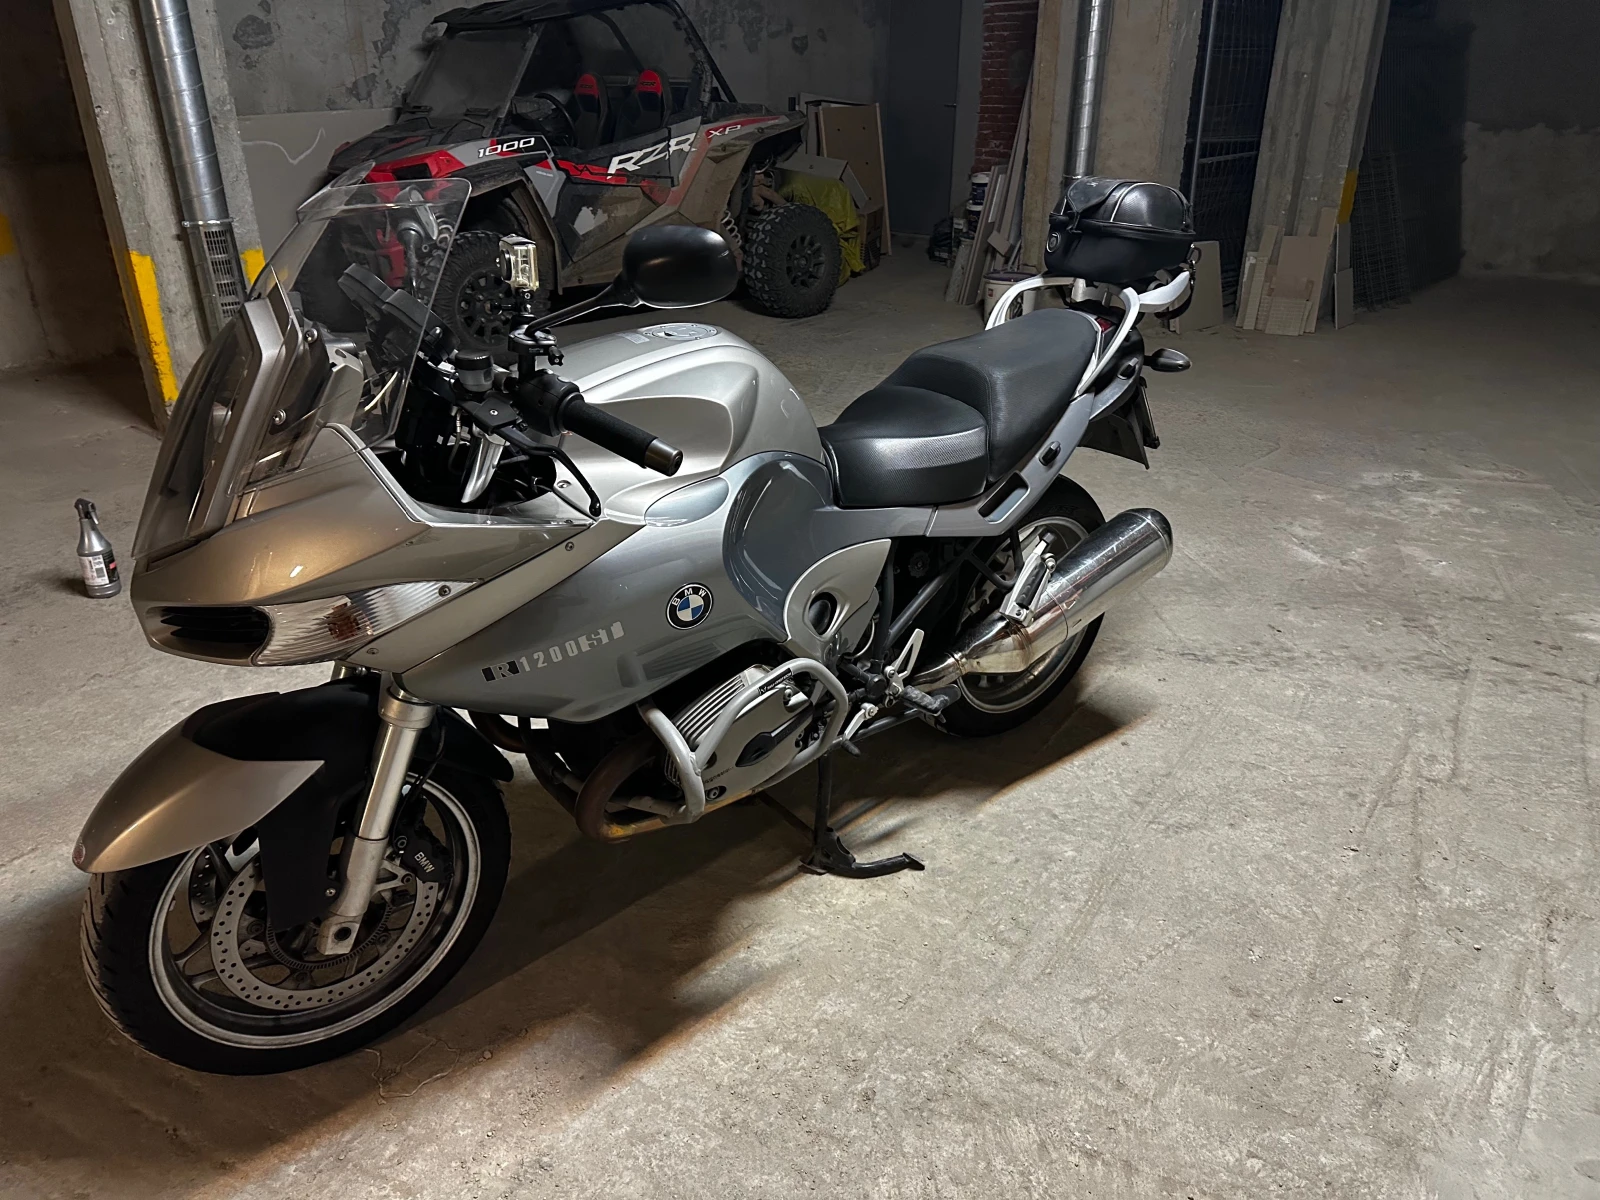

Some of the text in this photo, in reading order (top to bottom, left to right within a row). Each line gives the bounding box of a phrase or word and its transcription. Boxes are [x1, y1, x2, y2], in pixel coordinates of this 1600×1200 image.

[478, 137, 535, 158] 1000
[606, 124, 742, 179] RZR XP
[672, 587, 707, 606] BMW
[414, 851, 435, 873] BMW
